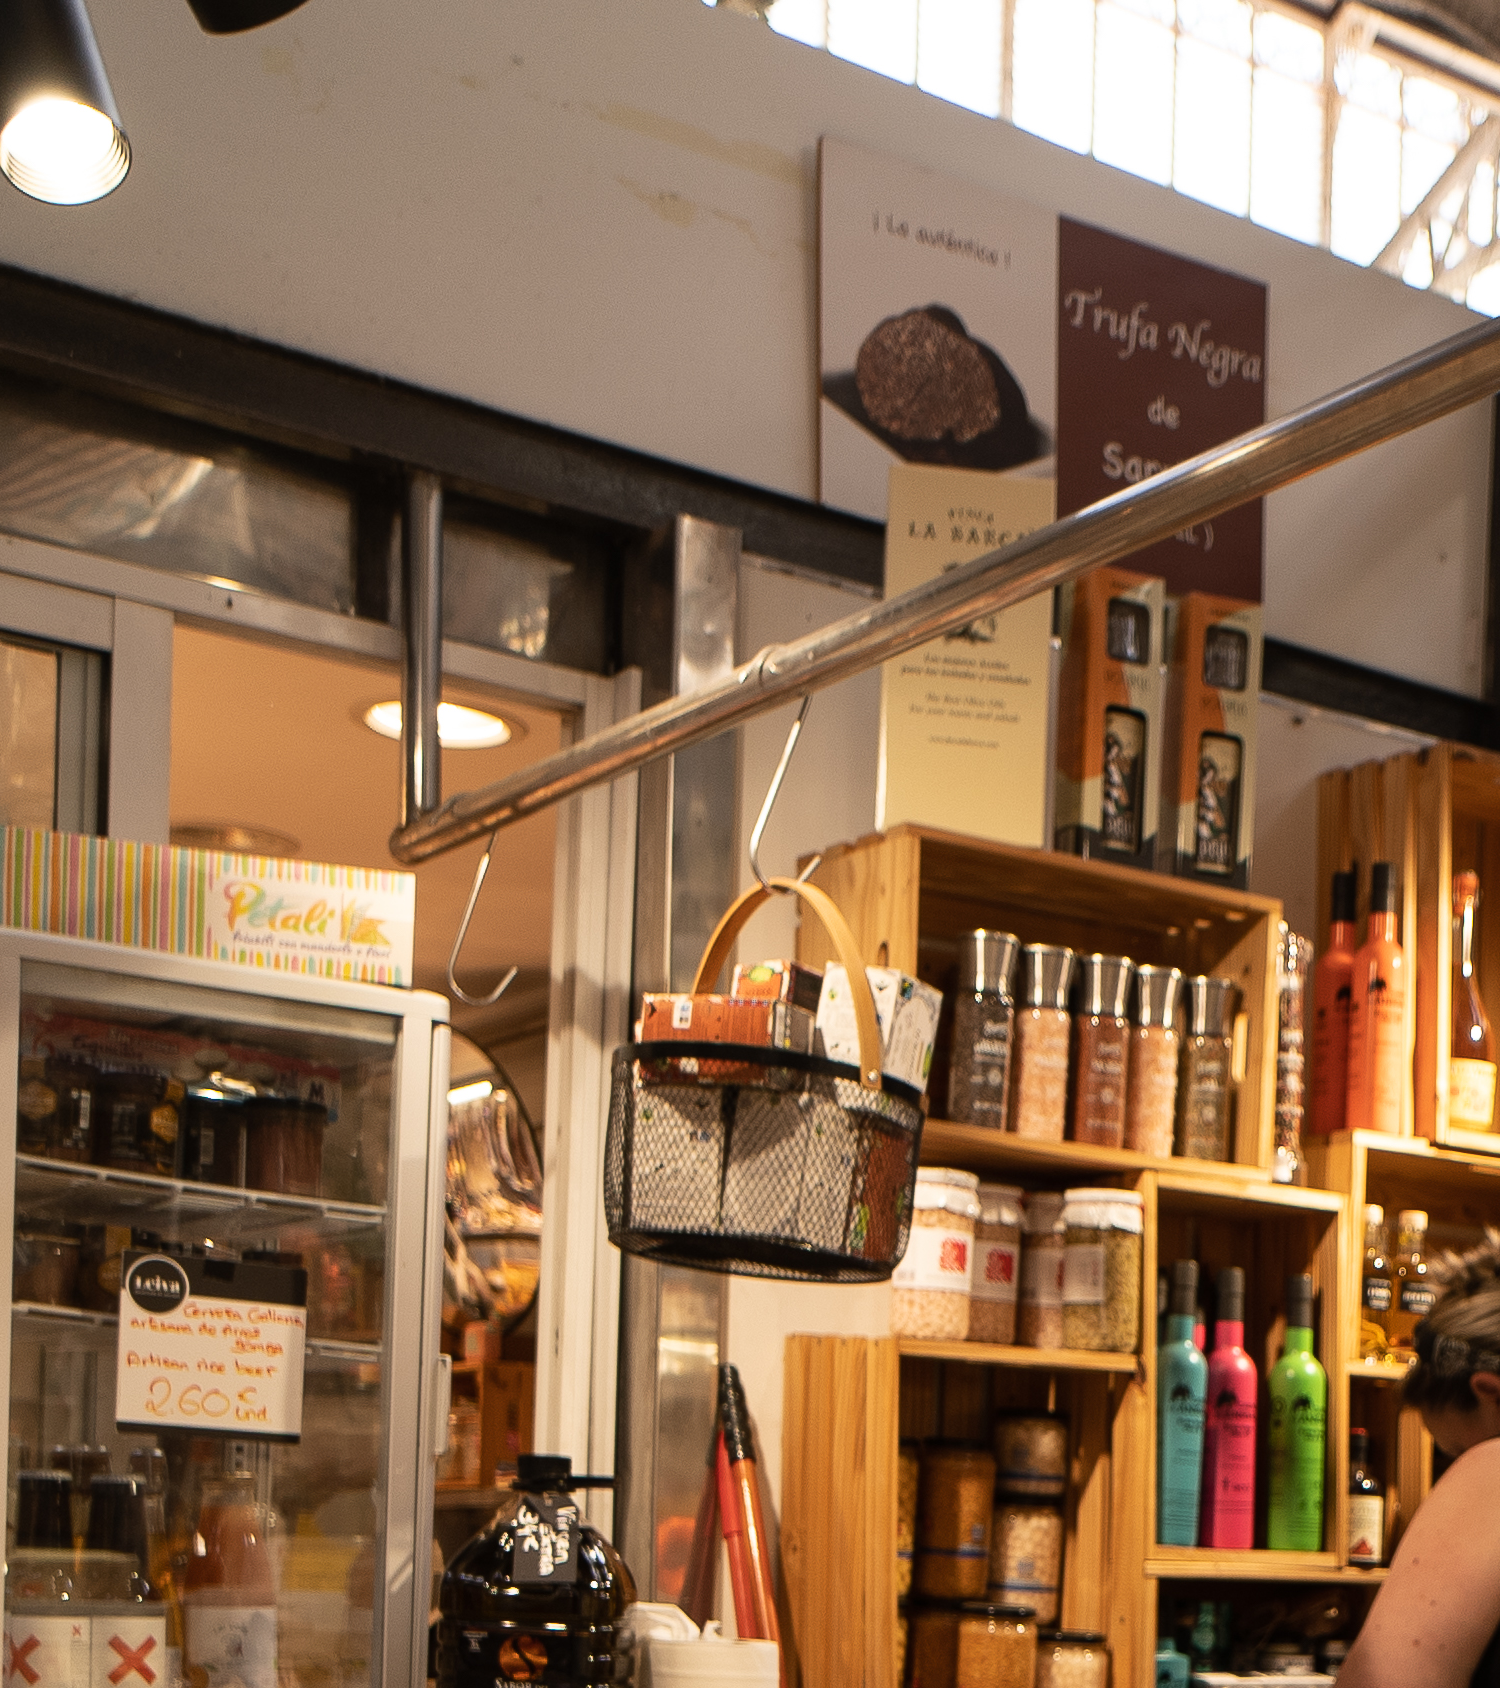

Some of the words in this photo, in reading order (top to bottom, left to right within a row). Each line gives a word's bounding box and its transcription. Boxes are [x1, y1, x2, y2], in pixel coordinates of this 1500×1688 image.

[1065, 287, 1159, 360] Trufa
[1168, 320, 1261, 387] Negra
[1148, 396, 1180, 430] de
[145, 1376, 230, 1418] 2.60
